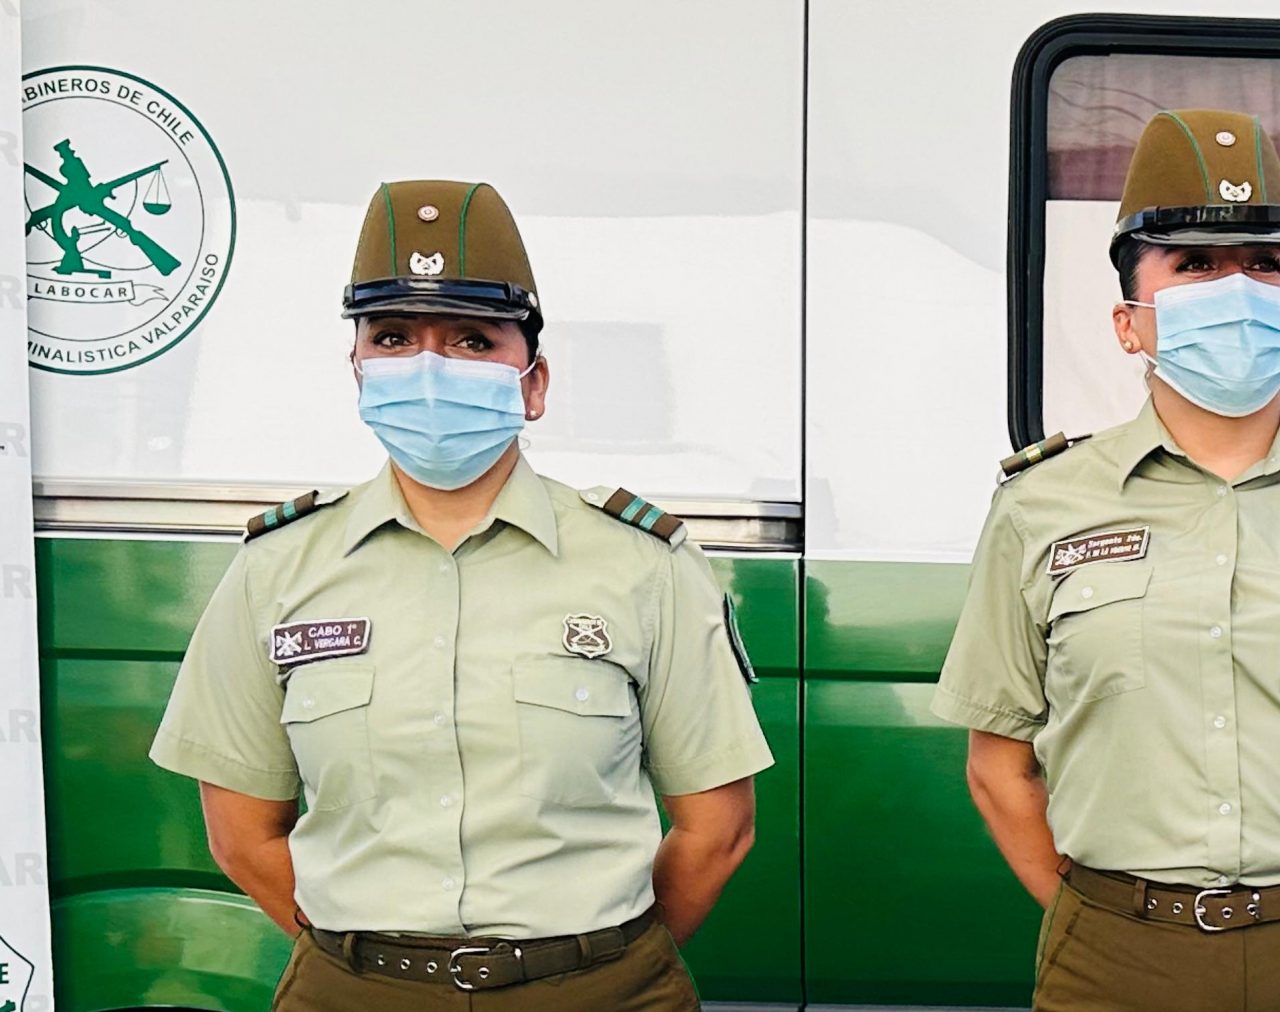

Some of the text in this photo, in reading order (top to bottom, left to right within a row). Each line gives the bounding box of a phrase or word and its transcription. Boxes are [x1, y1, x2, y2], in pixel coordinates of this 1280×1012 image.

[22, 78, 195, 147] BINEROS DE CHILE
[34, 282, 128, 298] LABOCAR
[141, 253, 219, 345] VALPARAISO
[308, 624, 342, 638] CABO
[314, 637, 351, 650] VERGARA
